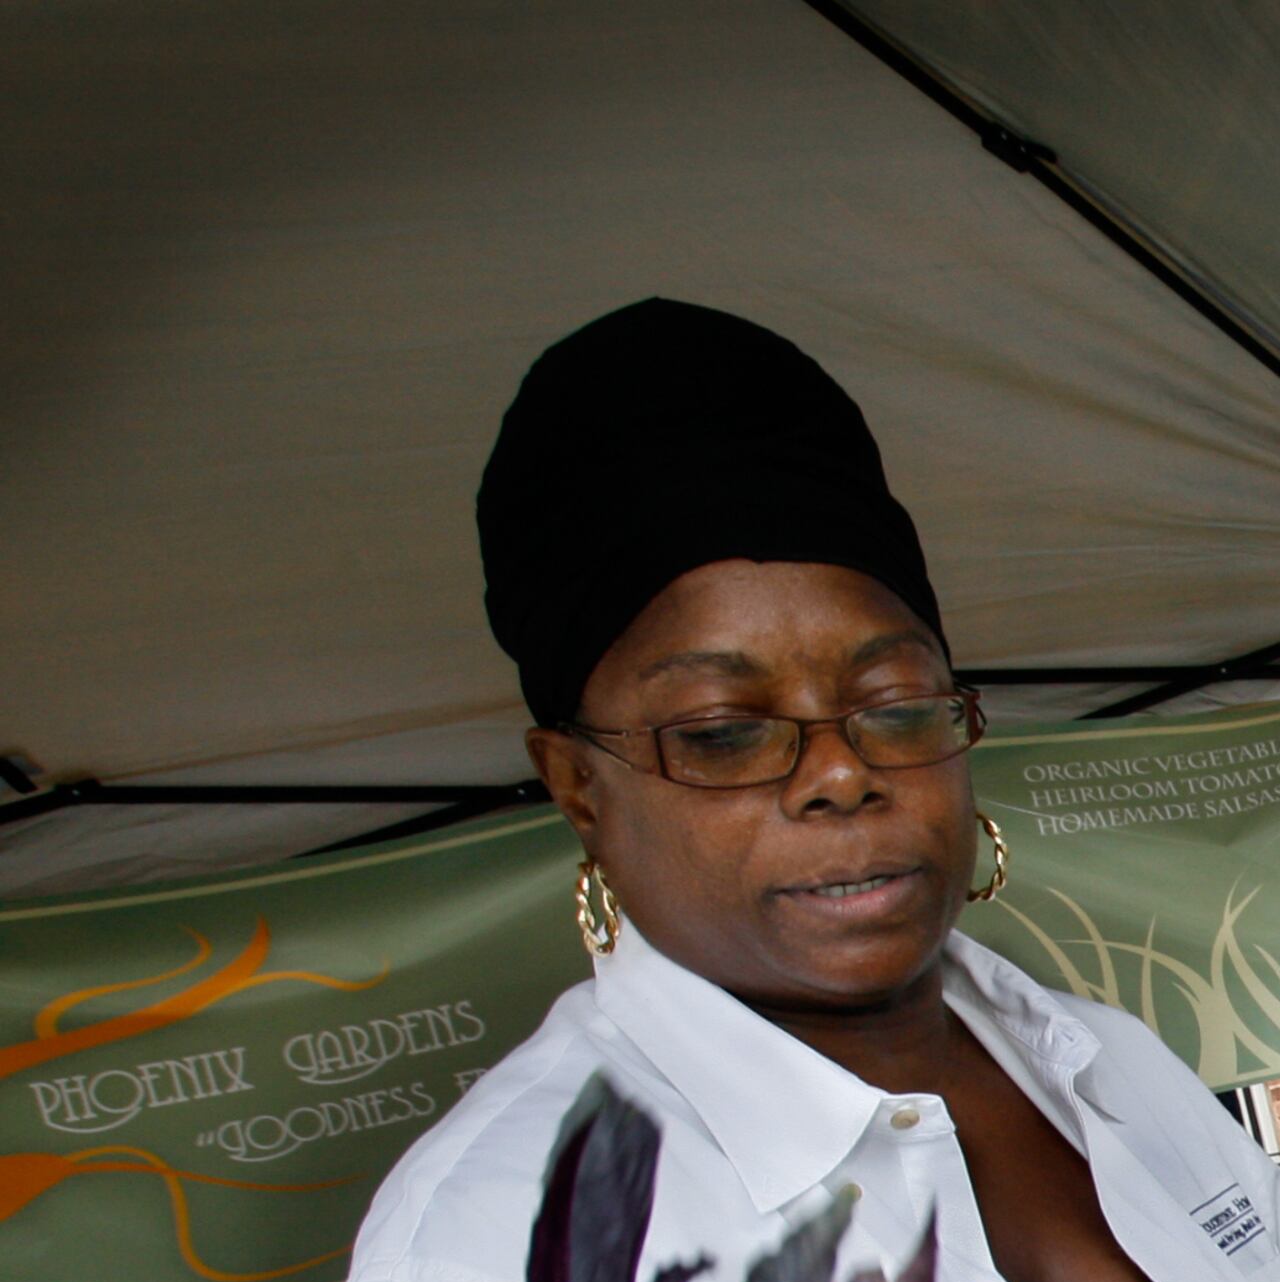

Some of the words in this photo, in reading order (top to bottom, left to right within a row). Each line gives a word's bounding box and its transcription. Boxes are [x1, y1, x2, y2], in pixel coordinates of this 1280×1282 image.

[1023, 757, 1152, 783] ORGANIC
[1029, 780, 1179, 808] HEIRLOOM
[1037, 803, 1200, 836] HOMEMADE
[29, 1046, 256, 1134] PHOENIX
[283, 1000, 486, 1085] GARDENS
